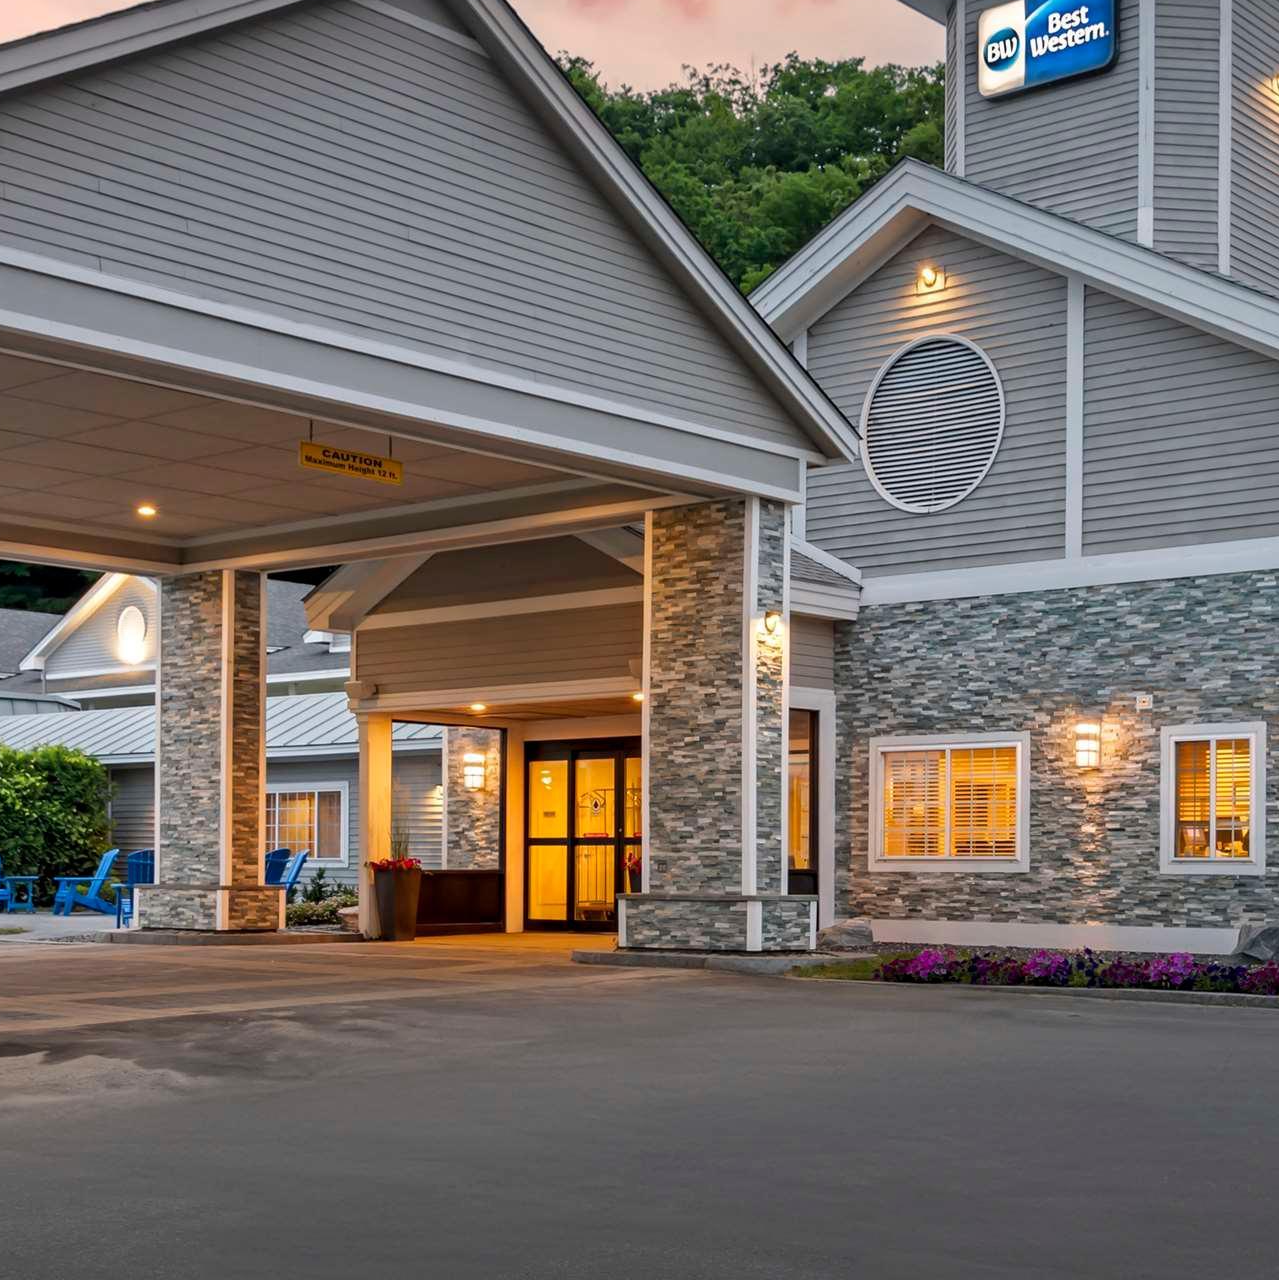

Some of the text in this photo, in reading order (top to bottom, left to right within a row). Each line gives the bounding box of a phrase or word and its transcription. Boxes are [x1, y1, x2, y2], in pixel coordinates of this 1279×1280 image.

[1048, 6, 1089, 34] Best
[987, 37, 1017, 63] BW
[304, 455, 346, 469] Maximum
[347, 463, 375, 476] Height
[322, 449, 383, 468] CAUTION
